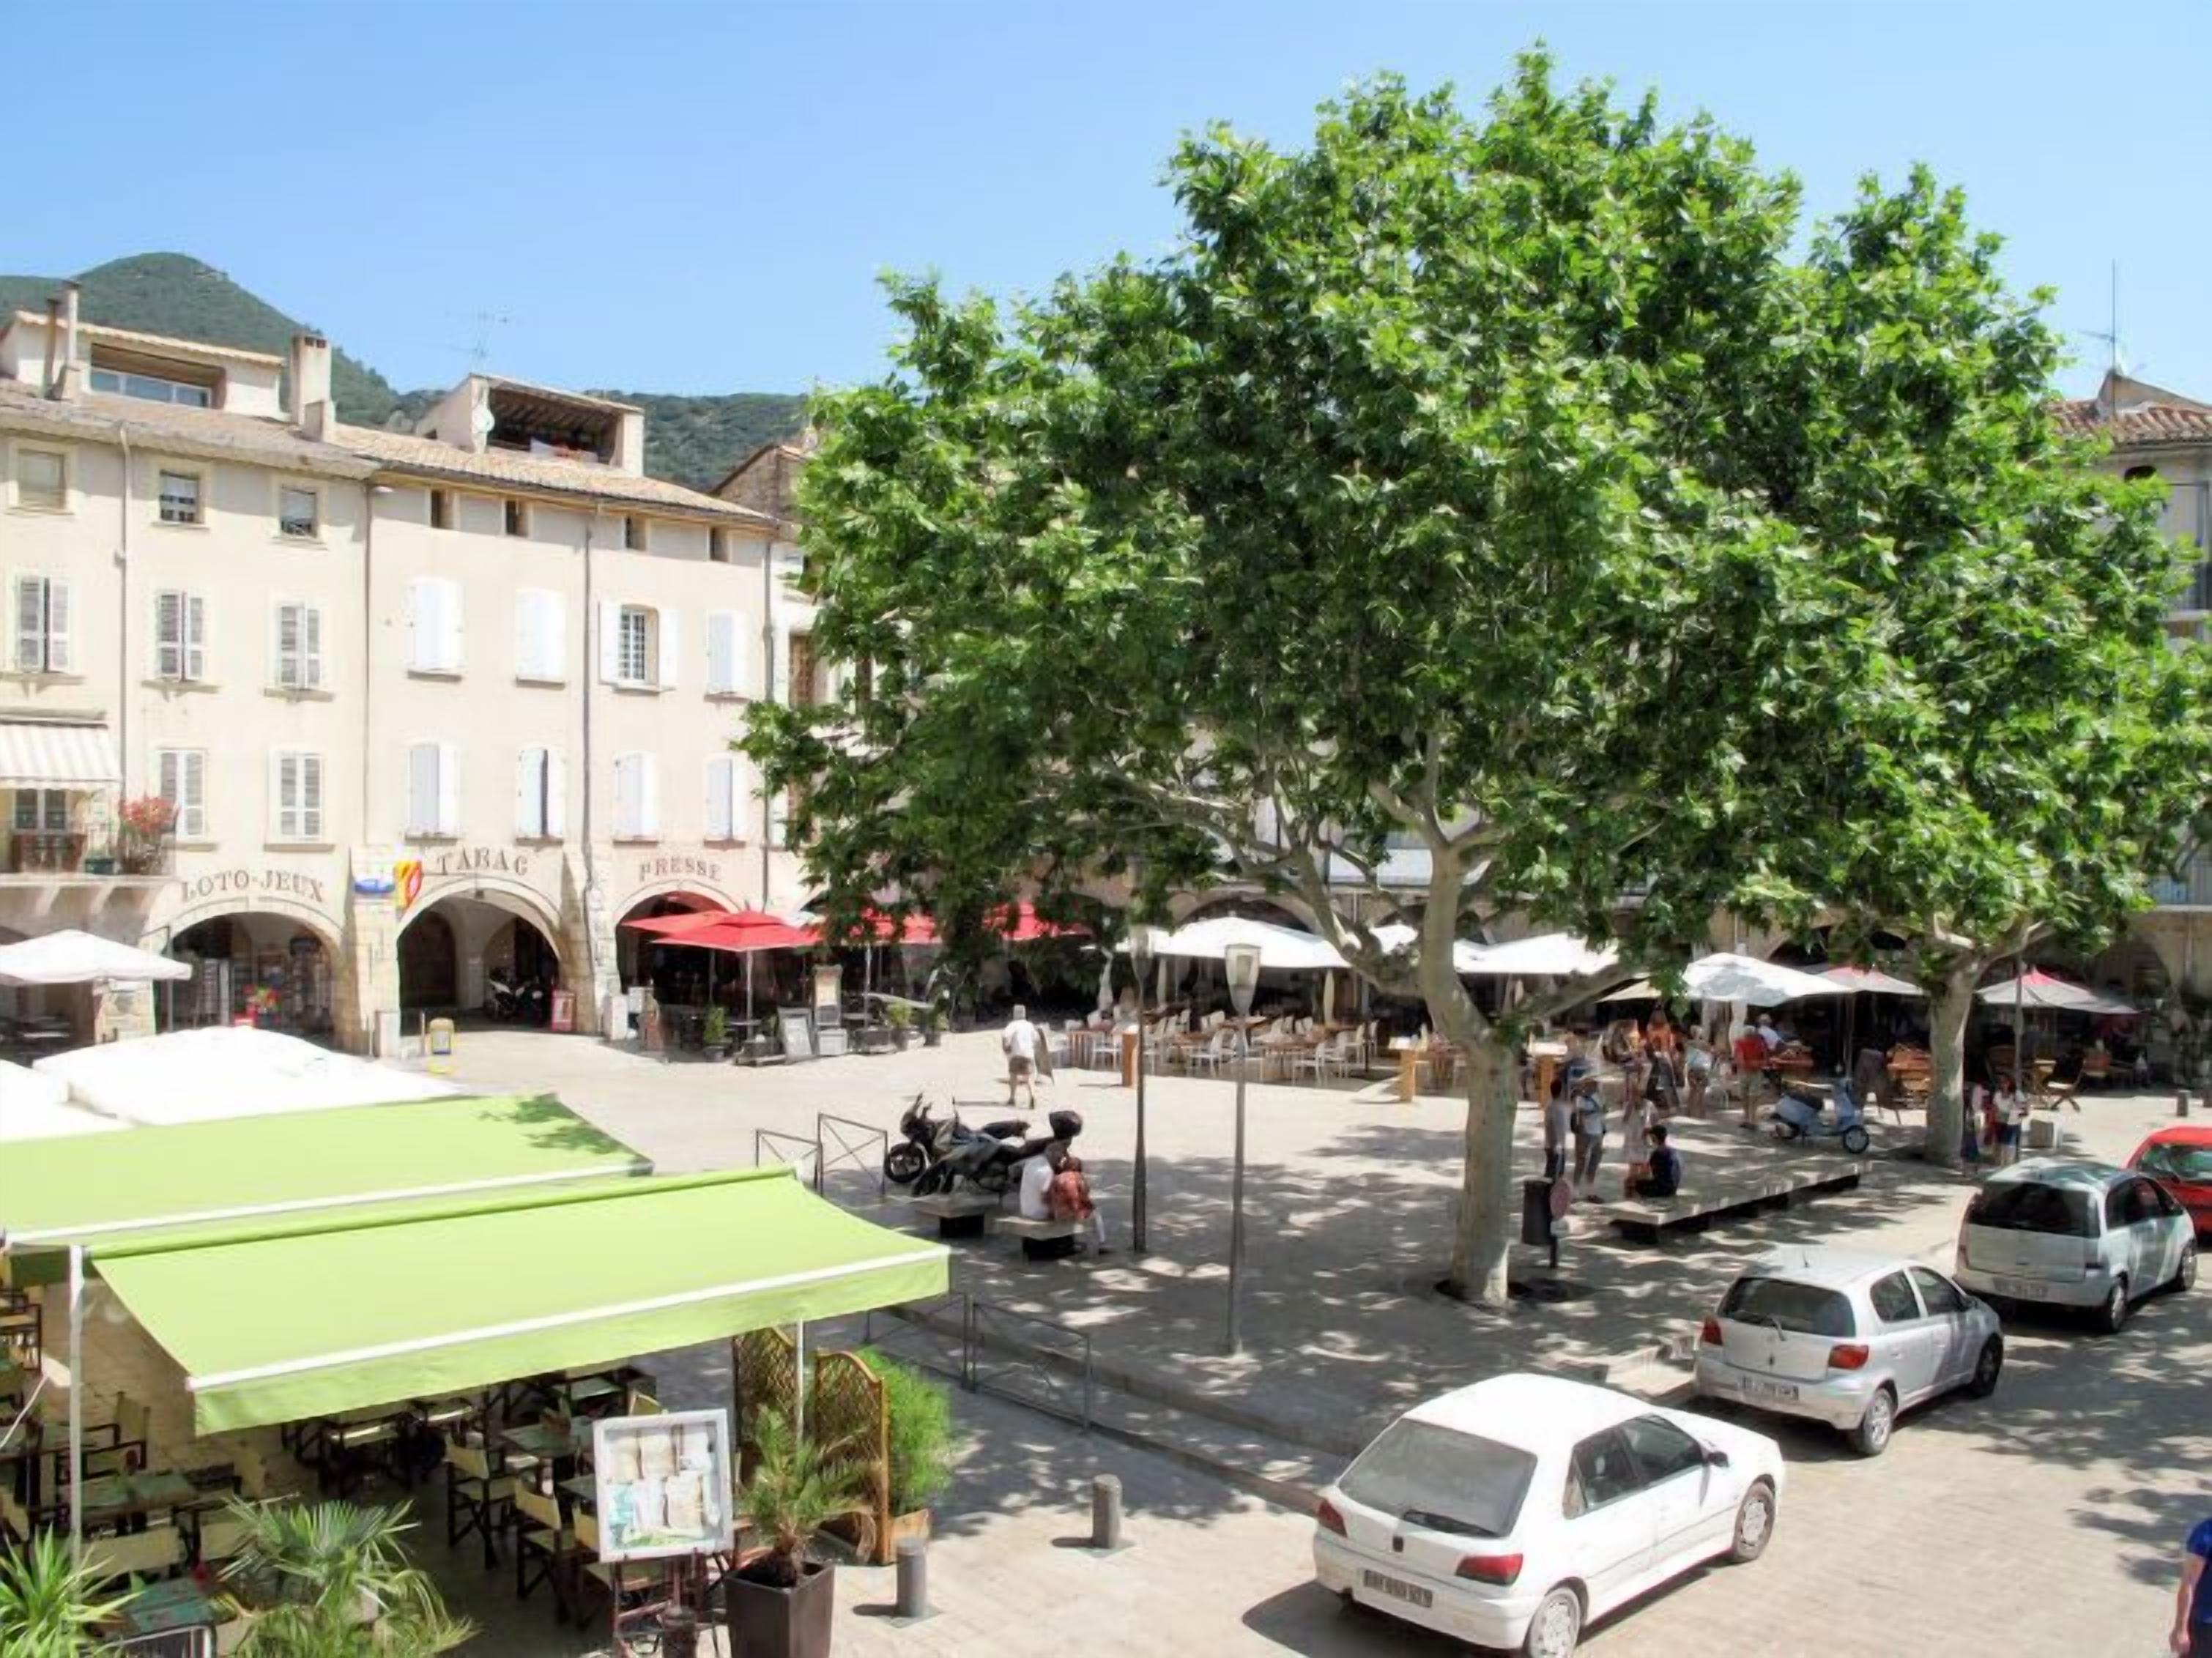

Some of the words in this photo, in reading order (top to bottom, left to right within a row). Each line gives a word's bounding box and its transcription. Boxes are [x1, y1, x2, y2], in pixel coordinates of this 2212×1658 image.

[437, 847, 528, 876] TABAC
[639, 856, 721, 882] PRESSE
[182, 869, 323, 902] LOTO-JEUX
